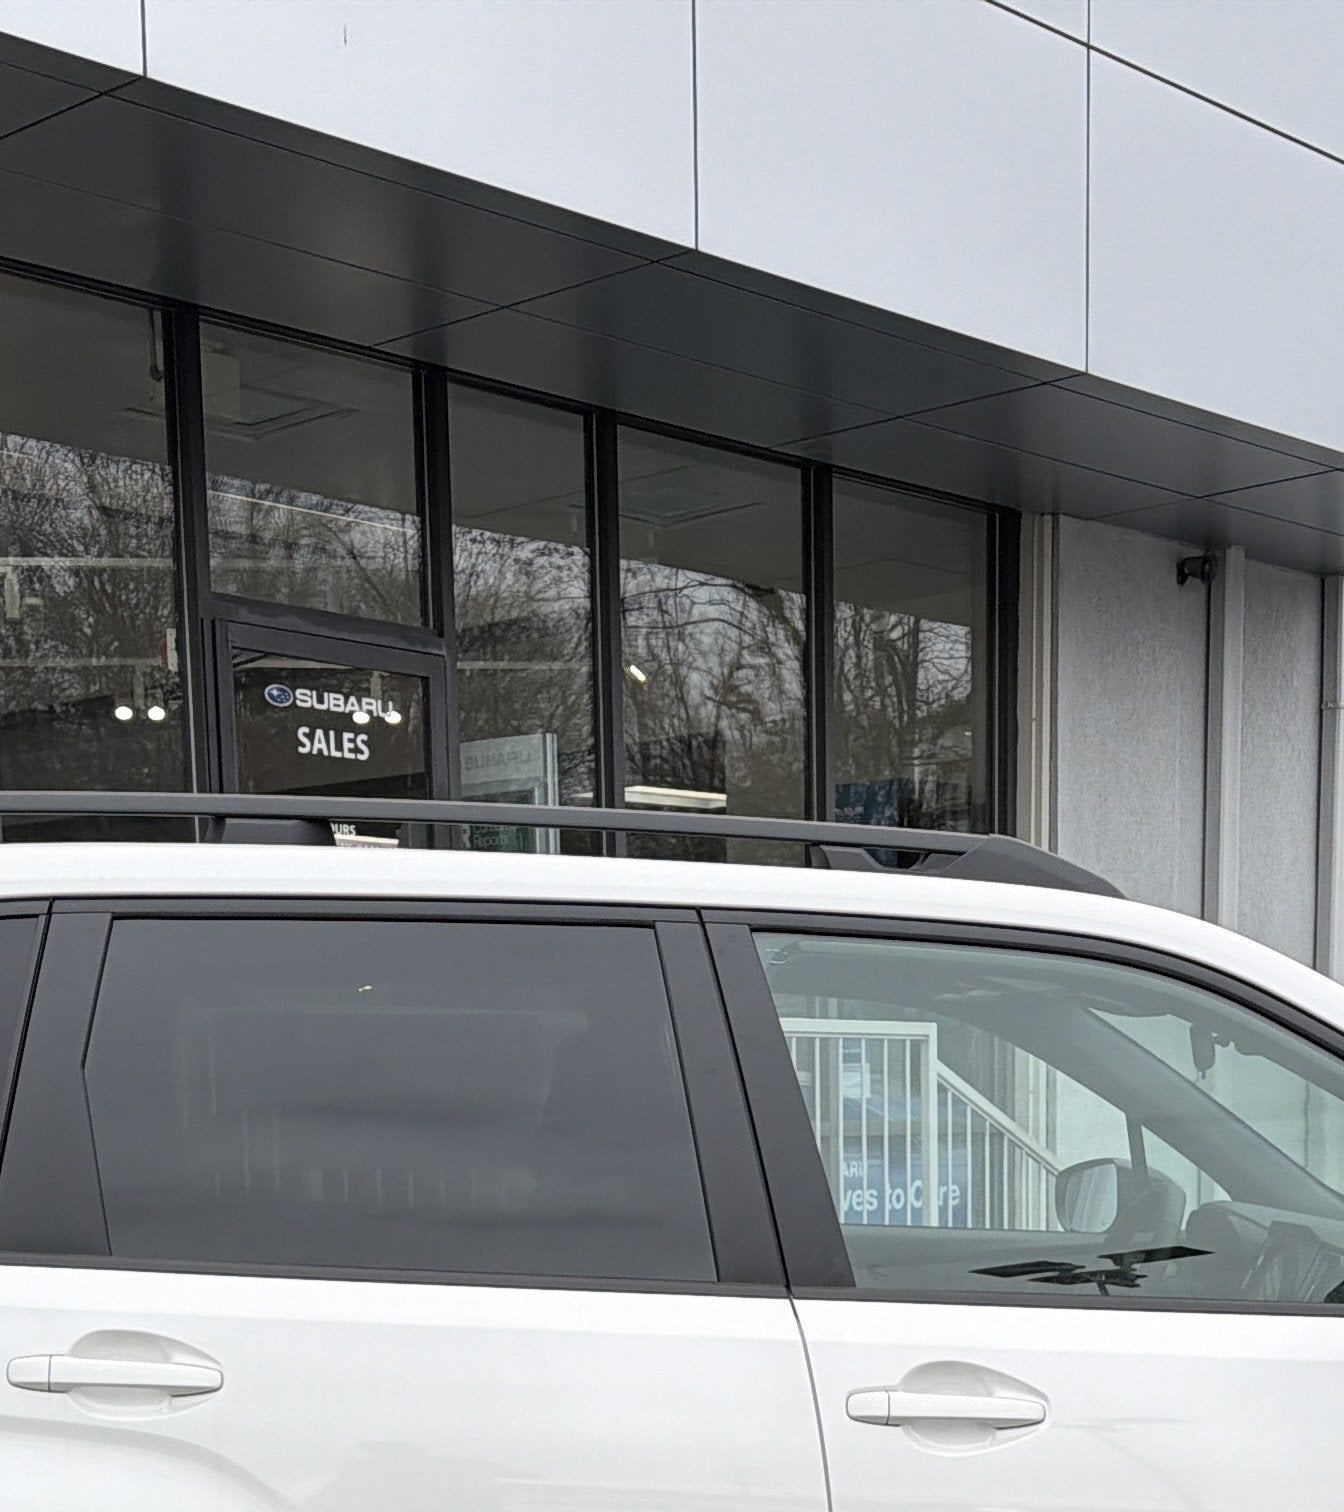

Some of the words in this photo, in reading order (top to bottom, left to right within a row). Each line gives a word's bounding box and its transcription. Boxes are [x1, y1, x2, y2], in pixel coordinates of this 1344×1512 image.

[294, 688, 395, 718] SUBARU
[297, 725, 370, 761] SALES
[464, 751, 532, 772] SUBARU
[330, 822, 357, 836] URS
[909, 1179, 961, 1209] Cre
